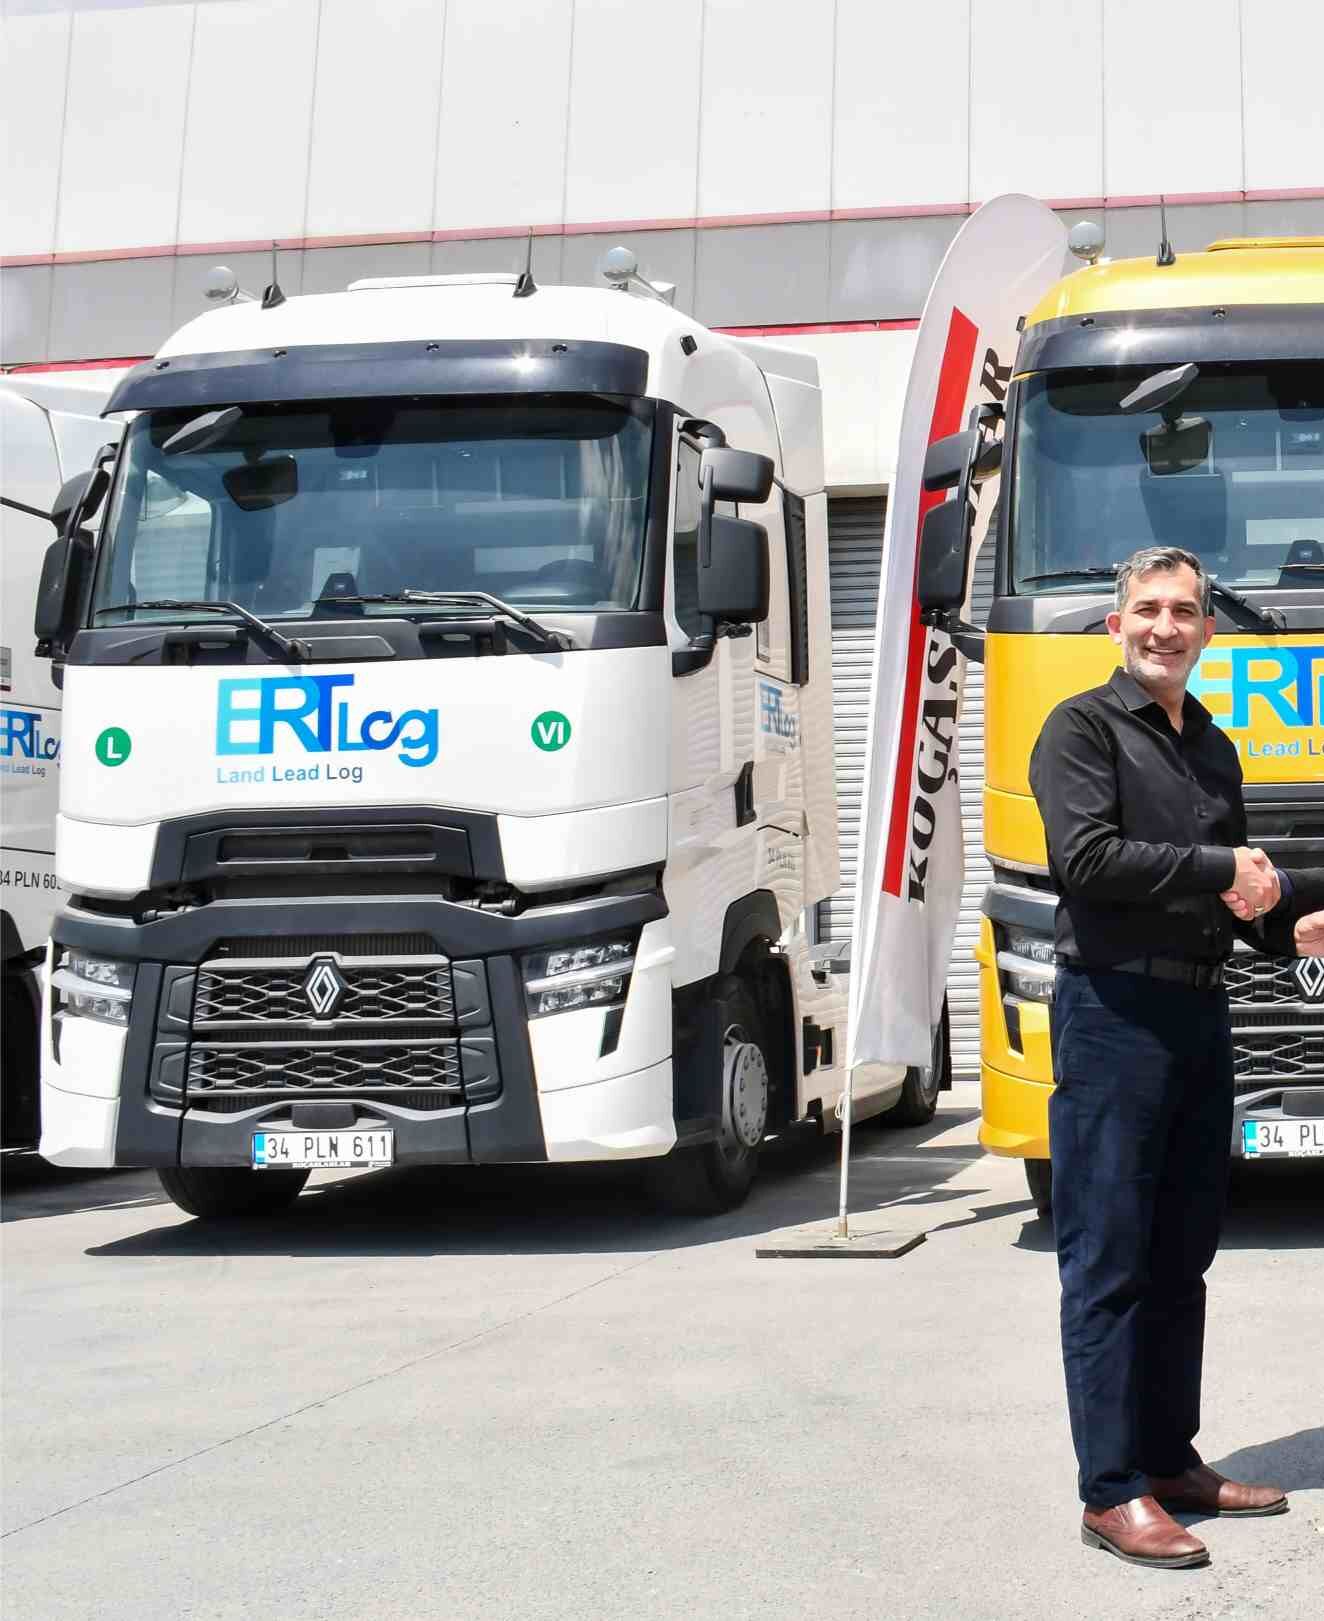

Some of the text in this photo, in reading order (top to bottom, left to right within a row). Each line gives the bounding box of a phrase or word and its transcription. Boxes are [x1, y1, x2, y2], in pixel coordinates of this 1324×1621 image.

[216, 673, 439, 767] ERTLog
[537, 722, 564, 744] VI
[106, 737, 122, 759] L
[1248, 741, 1301, 757] Lead
[216, 763, 363, 784] Land Lead Log
[15, 871, 40, 888] PLN
[43, 873, 62, 890] 60
[267, 1135, 387, 1159] 34 PLN 611
[1260, 1125, 1284, 1148] 34
